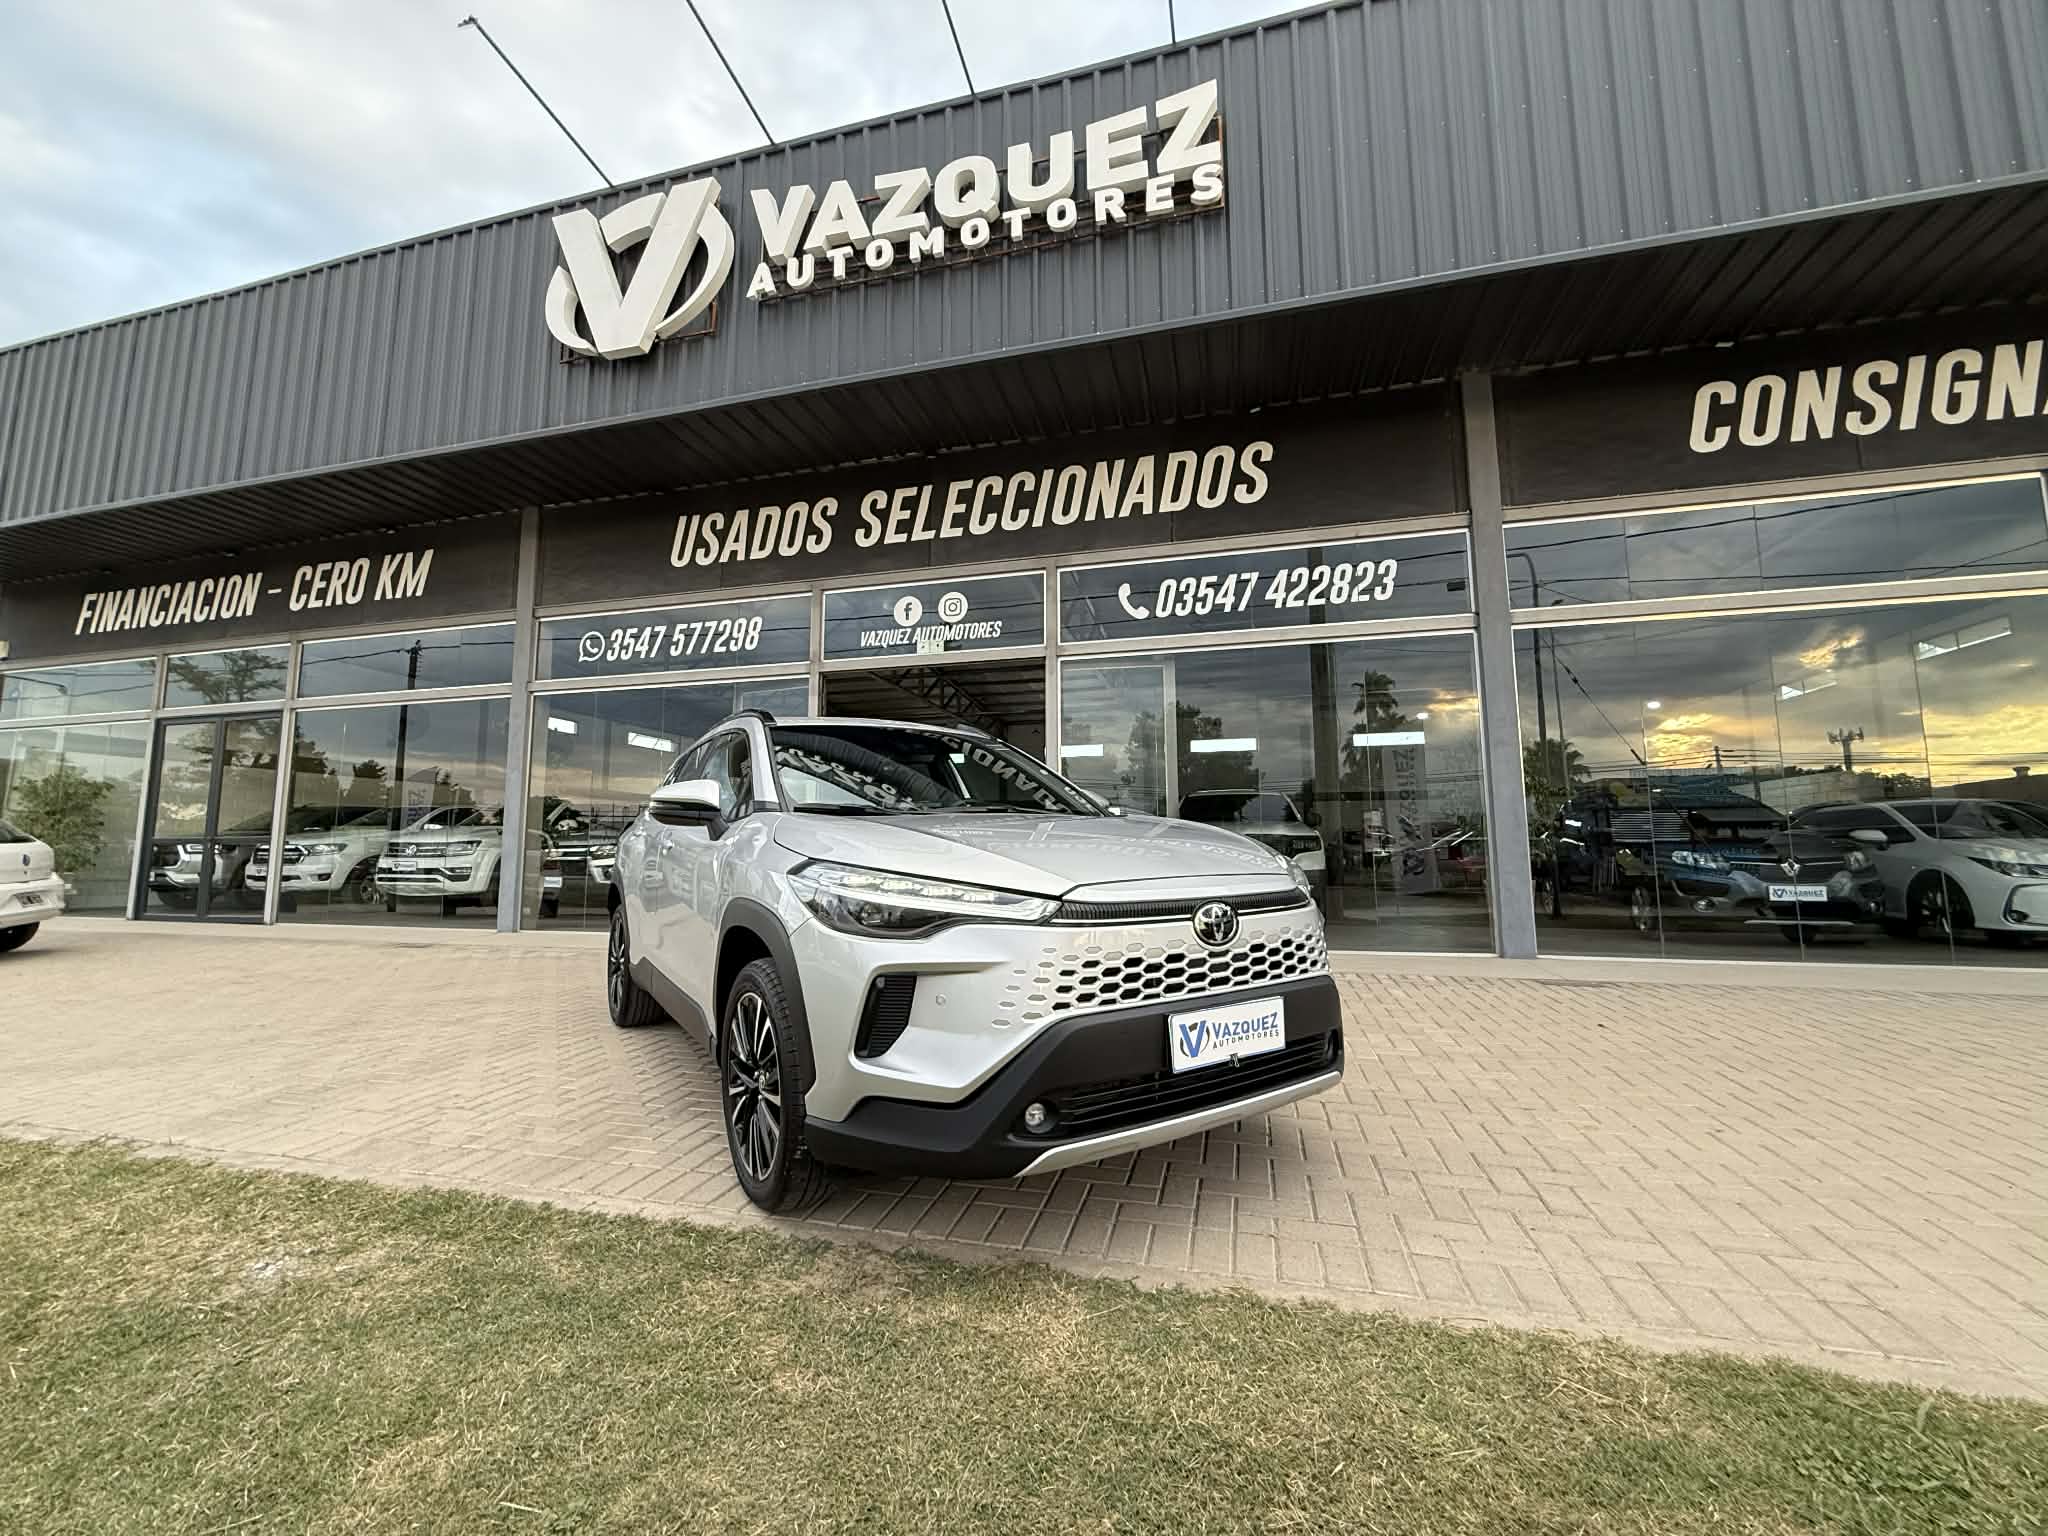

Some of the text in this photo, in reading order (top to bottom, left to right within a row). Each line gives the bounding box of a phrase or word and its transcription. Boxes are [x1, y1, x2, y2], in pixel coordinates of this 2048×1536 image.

[750, 78, 1223, 264] VAZQUEZ
[746, 162, 1225, 301] AUTOMOTORES
[1688, 340, 2048, 453] CONSIGN
[670, 441, 1274, 568] USADOS SELECCIONADOS
[75, 572, 263, 635] FINANCIACION
[288, 557, 369, 611] CERO
[373, 549, 434, 601] KM
[1154, 559, 1398, 618] 03547 422823
[606, 616, 763, 661] 3547 577298
[860, 621, 1002, 648] VAZQUEZ AUTOMOTORES
[1211, 1012, 1278, 1039] VAZQUEZ
[1212, 1030, 1280, 1049] AUTOMOTORES
